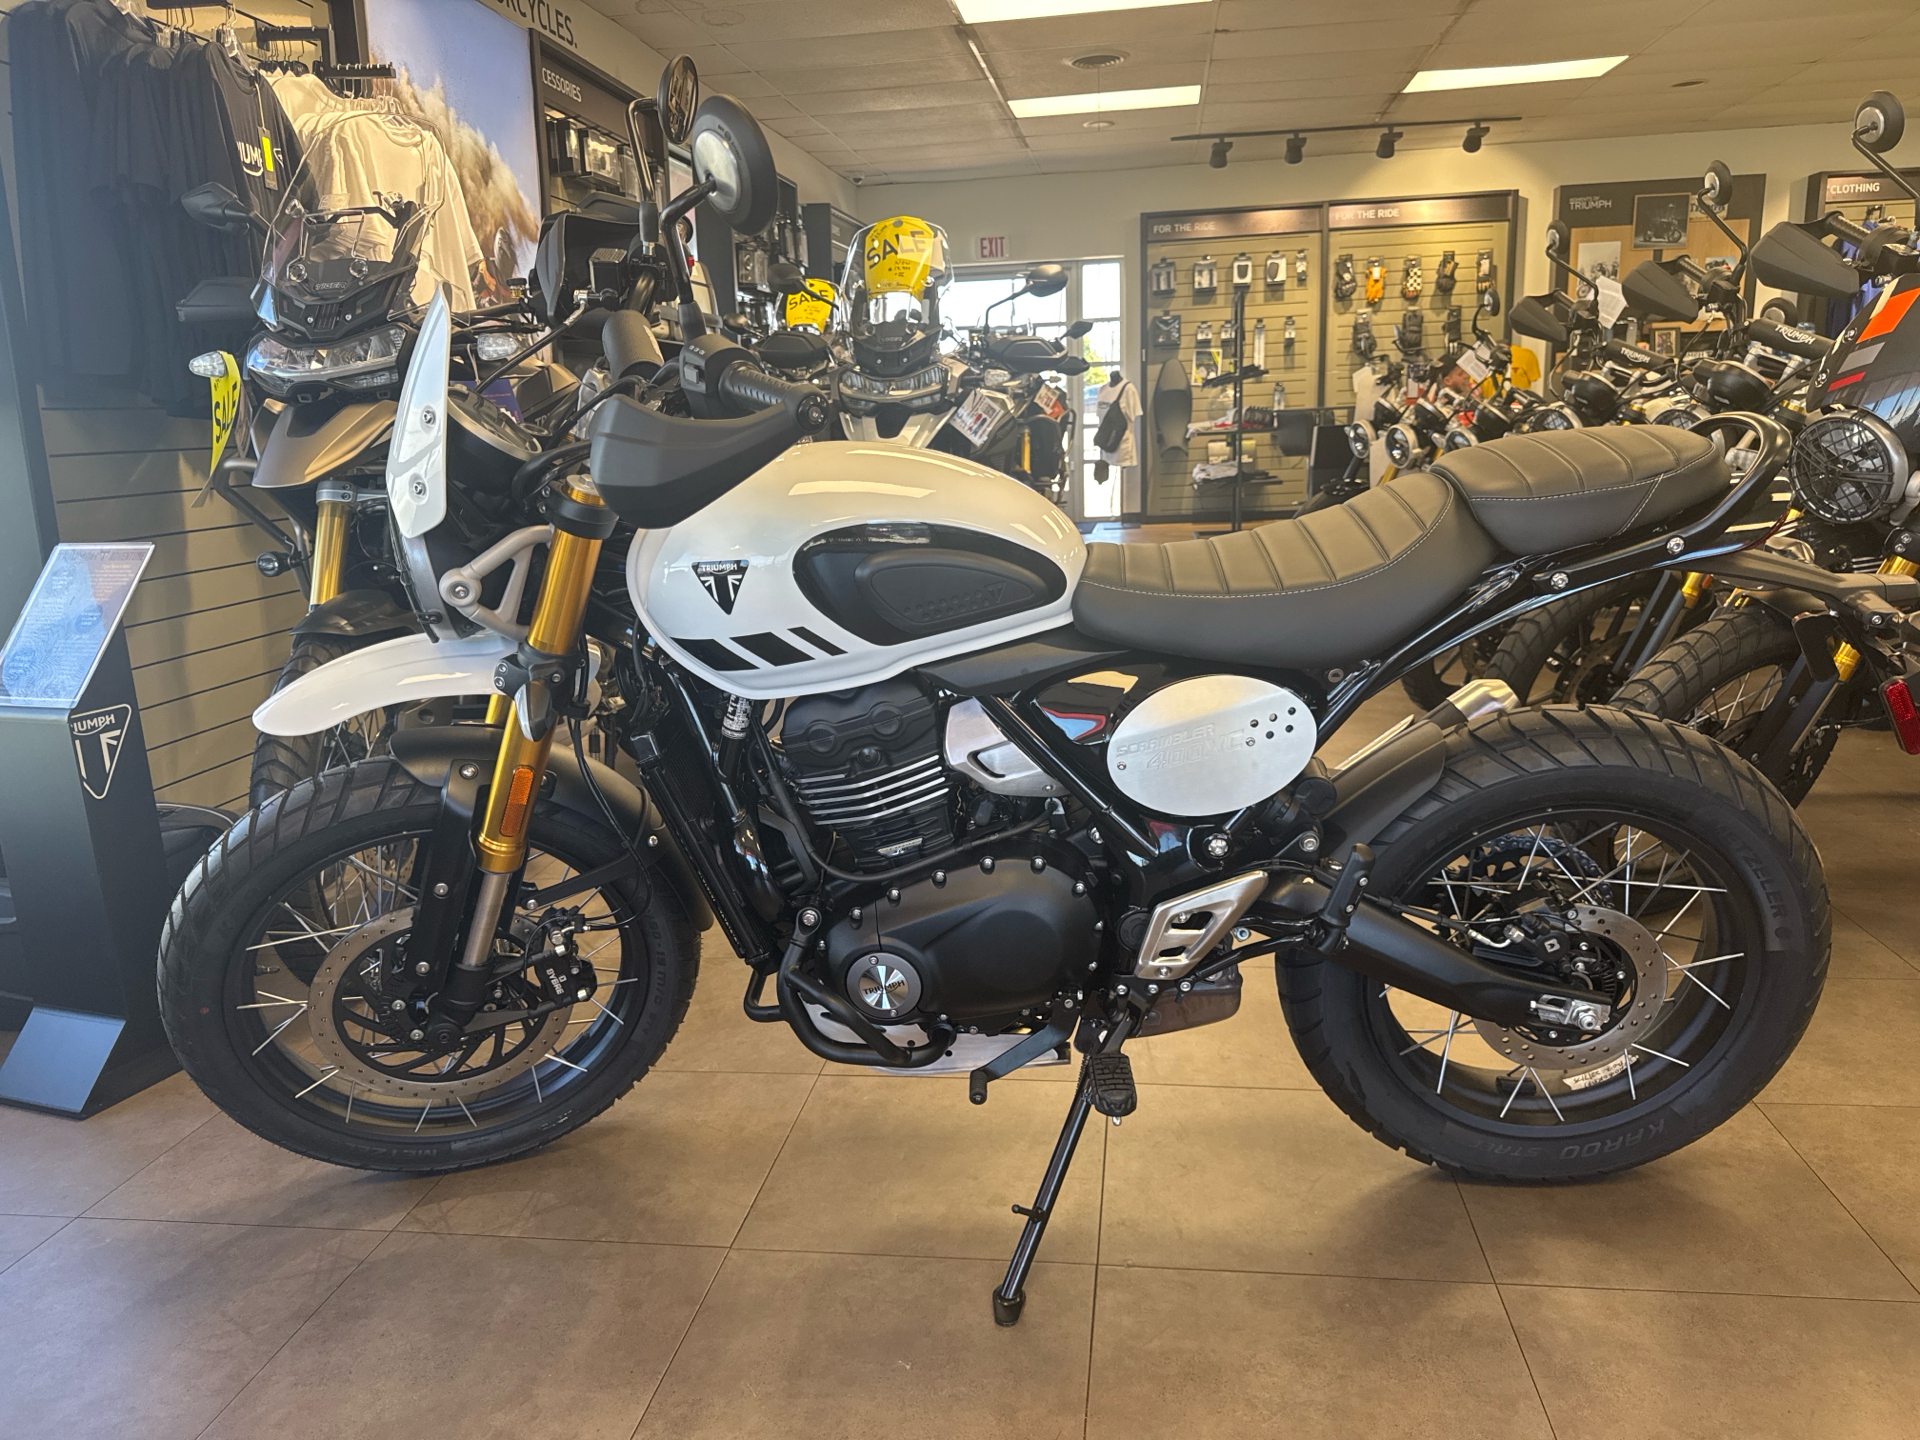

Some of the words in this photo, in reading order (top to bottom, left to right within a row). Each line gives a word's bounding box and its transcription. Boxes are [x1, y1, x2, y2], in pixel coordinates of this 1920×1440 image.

[1830, 182, 1881, 195] CLOTHING
[1333, 211, 1354, 221] FOR
[1356, 209, 1376, 219] THE
[1377, 207, 1400, 218] RIDE
[1569, 199, 1612, 210] TRIUMPH
[1153, 224, 1172, 234] FOR
[1173, 222, 1192, 233] THE
[1193, 220, 1216, 231] RIDE
[866, 230, 926, 270] SALE
[980, 236, 1005, 258] EXIT
[1774, 324, 1816, 345] TRIUMPH
[1620, 346, 1651, 364] TRIUMPH
[214, 380, 238, 444] SALE
[701, 563, 738, 573] TRIUMPH
[70, 713, 116, 733] IUMPH
[1116, 722, 1216, 758] SCRAMBLER
[546, 968, 565, 995] BYBRE
[863, 979, 906, 995] TRIUMPH
[1558, 1118, 1665, 1160] KAROO
